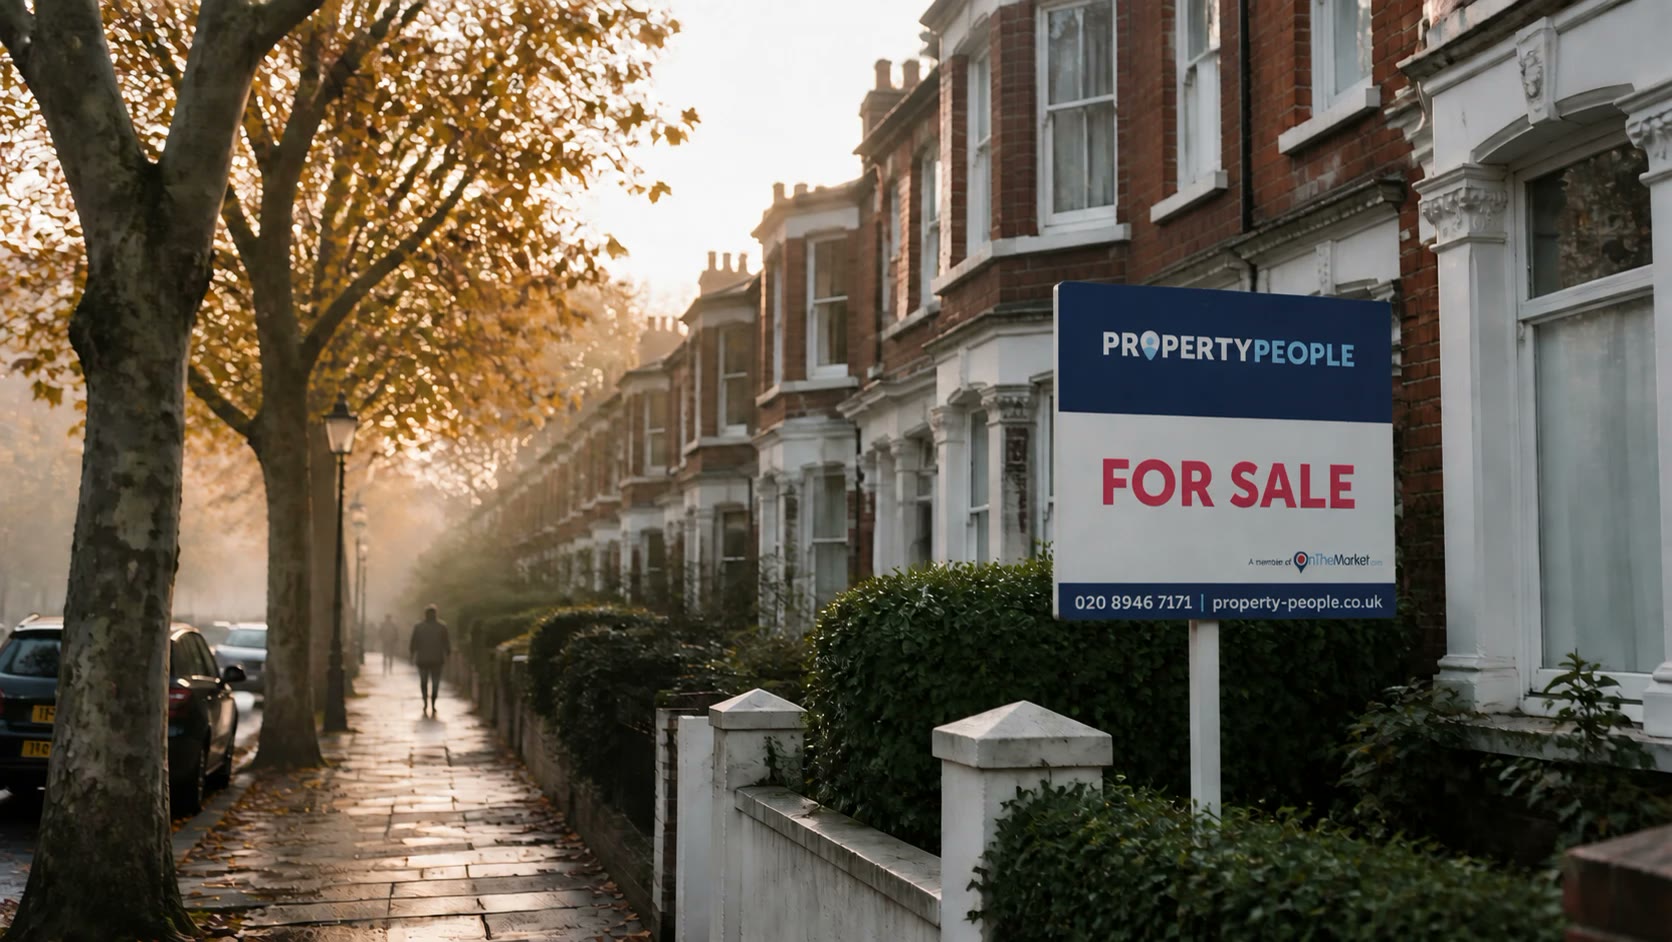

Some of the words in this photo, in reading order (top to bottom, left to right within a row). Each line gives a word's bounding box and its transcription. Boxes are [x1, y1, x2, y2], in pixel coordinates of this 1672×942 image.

[1102, 458, 1215, 507] FOR
[1229, 461, 1355, 509] SALE
[1248, 558, 1254, 566] A
[1075, 595, 1106, 610] 020
[1111, 595, 1153, 610] 8946
[1158, 595, 1193, 610] 7171
[1213, 594, 1383, 613] property-people.co.uk
